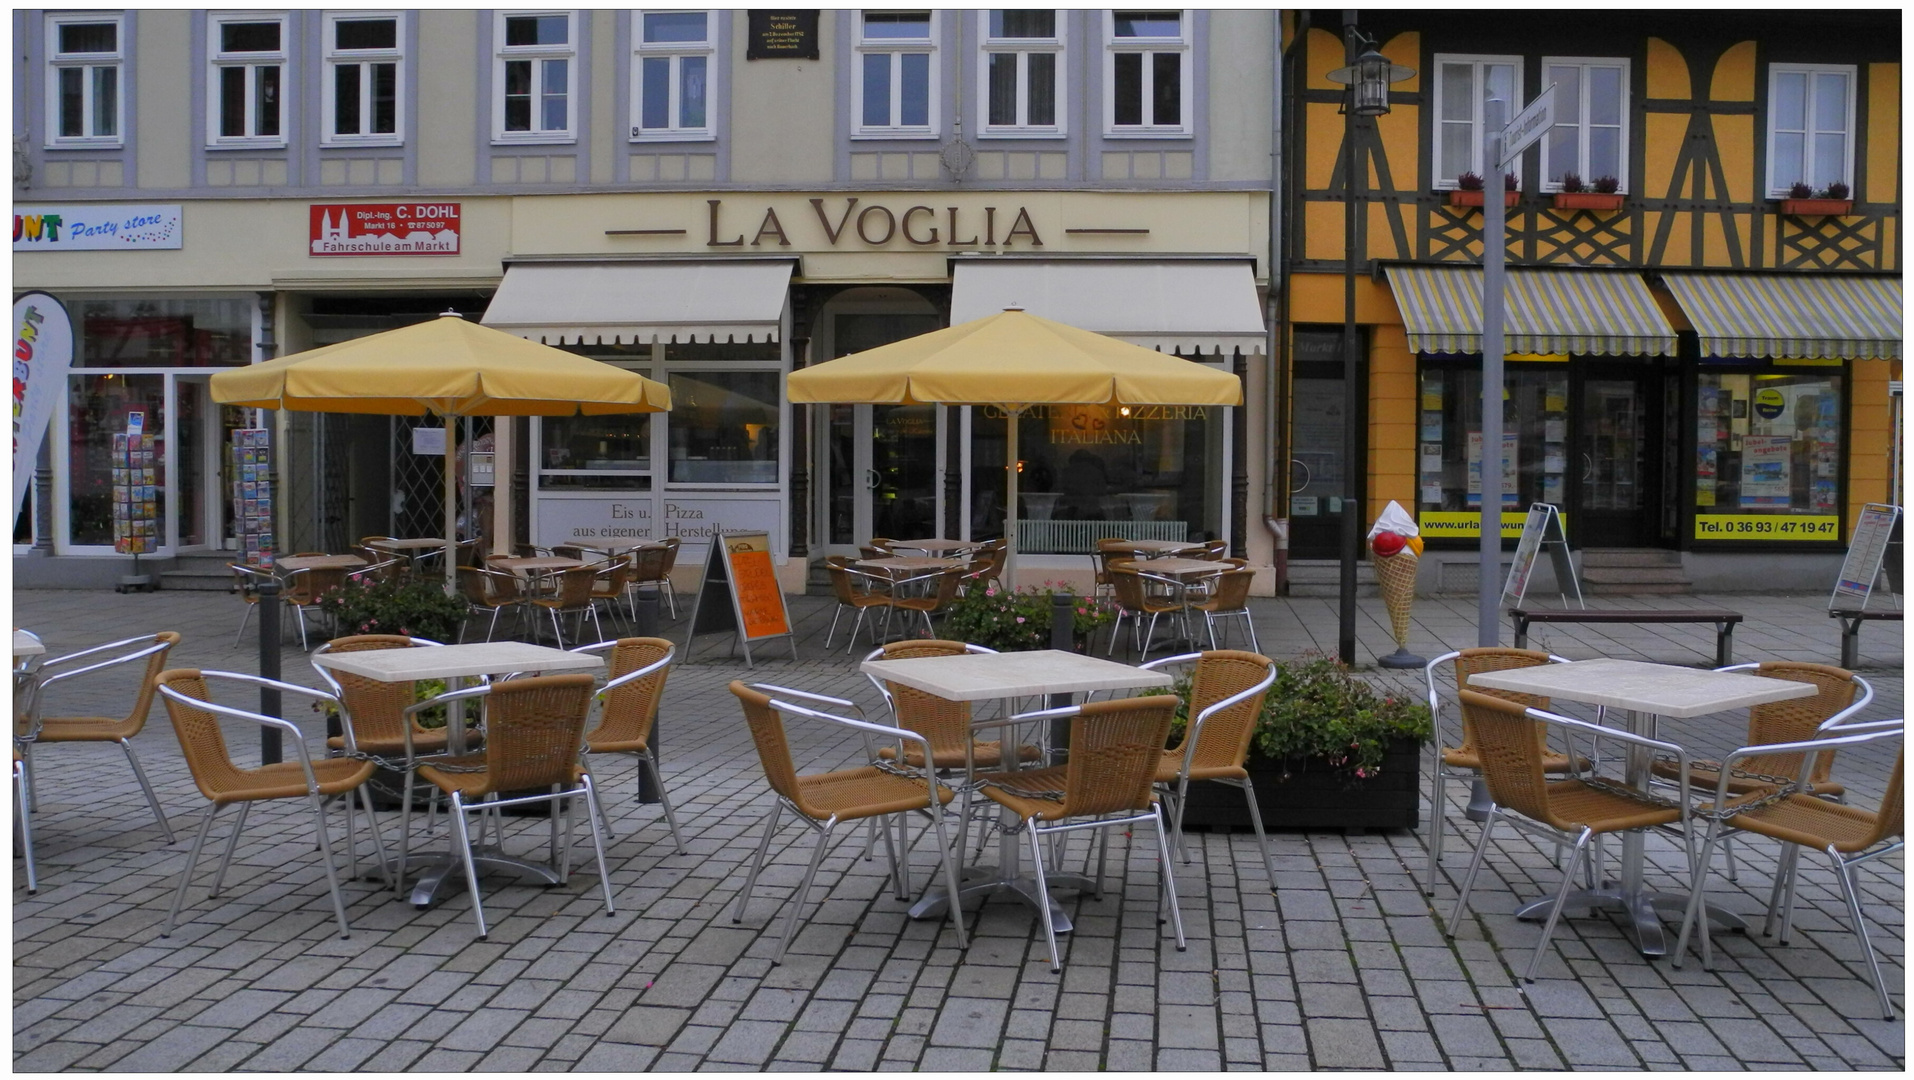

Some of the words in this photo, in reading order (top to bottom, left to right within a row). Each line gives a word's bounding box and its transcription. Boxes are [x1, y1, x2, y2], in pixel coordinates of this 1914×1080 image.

[356, 211, 392, 221] Dipl.-Ing.
[396, 206, 411, 219] C.
[416, 205, 458, 218] DOHL
[70, 222, 118, 240] Party
[124, 214, 162, 230] store
[809, 198, 1044, 246] VOGLIA
[323, 241, 391, 251] Fahrschule
[394, 243, 411, 251] am
[415, 241, 450, 251] Markt
[1051, 429, 1142, 445] ITALIANA
[612, 504, 634, 519] Eis
[639, 507, 651, 519] u.
[665, 504, 704, 519] Pizza
[573, 527, 596, 537] aus
[600, 524, 650, 538] eigener
[1699, 521, 1723, 533] Tel.
[1726, 522, 1734, 533] 0
[1737, 522, 1753, 533] 36
[1756, 522, 1772, 533] 93
[1781, 522, 1797, 533] 47
[1800, 522, 1816, 533] 19
[1818, 522, 1834, 533] 47
